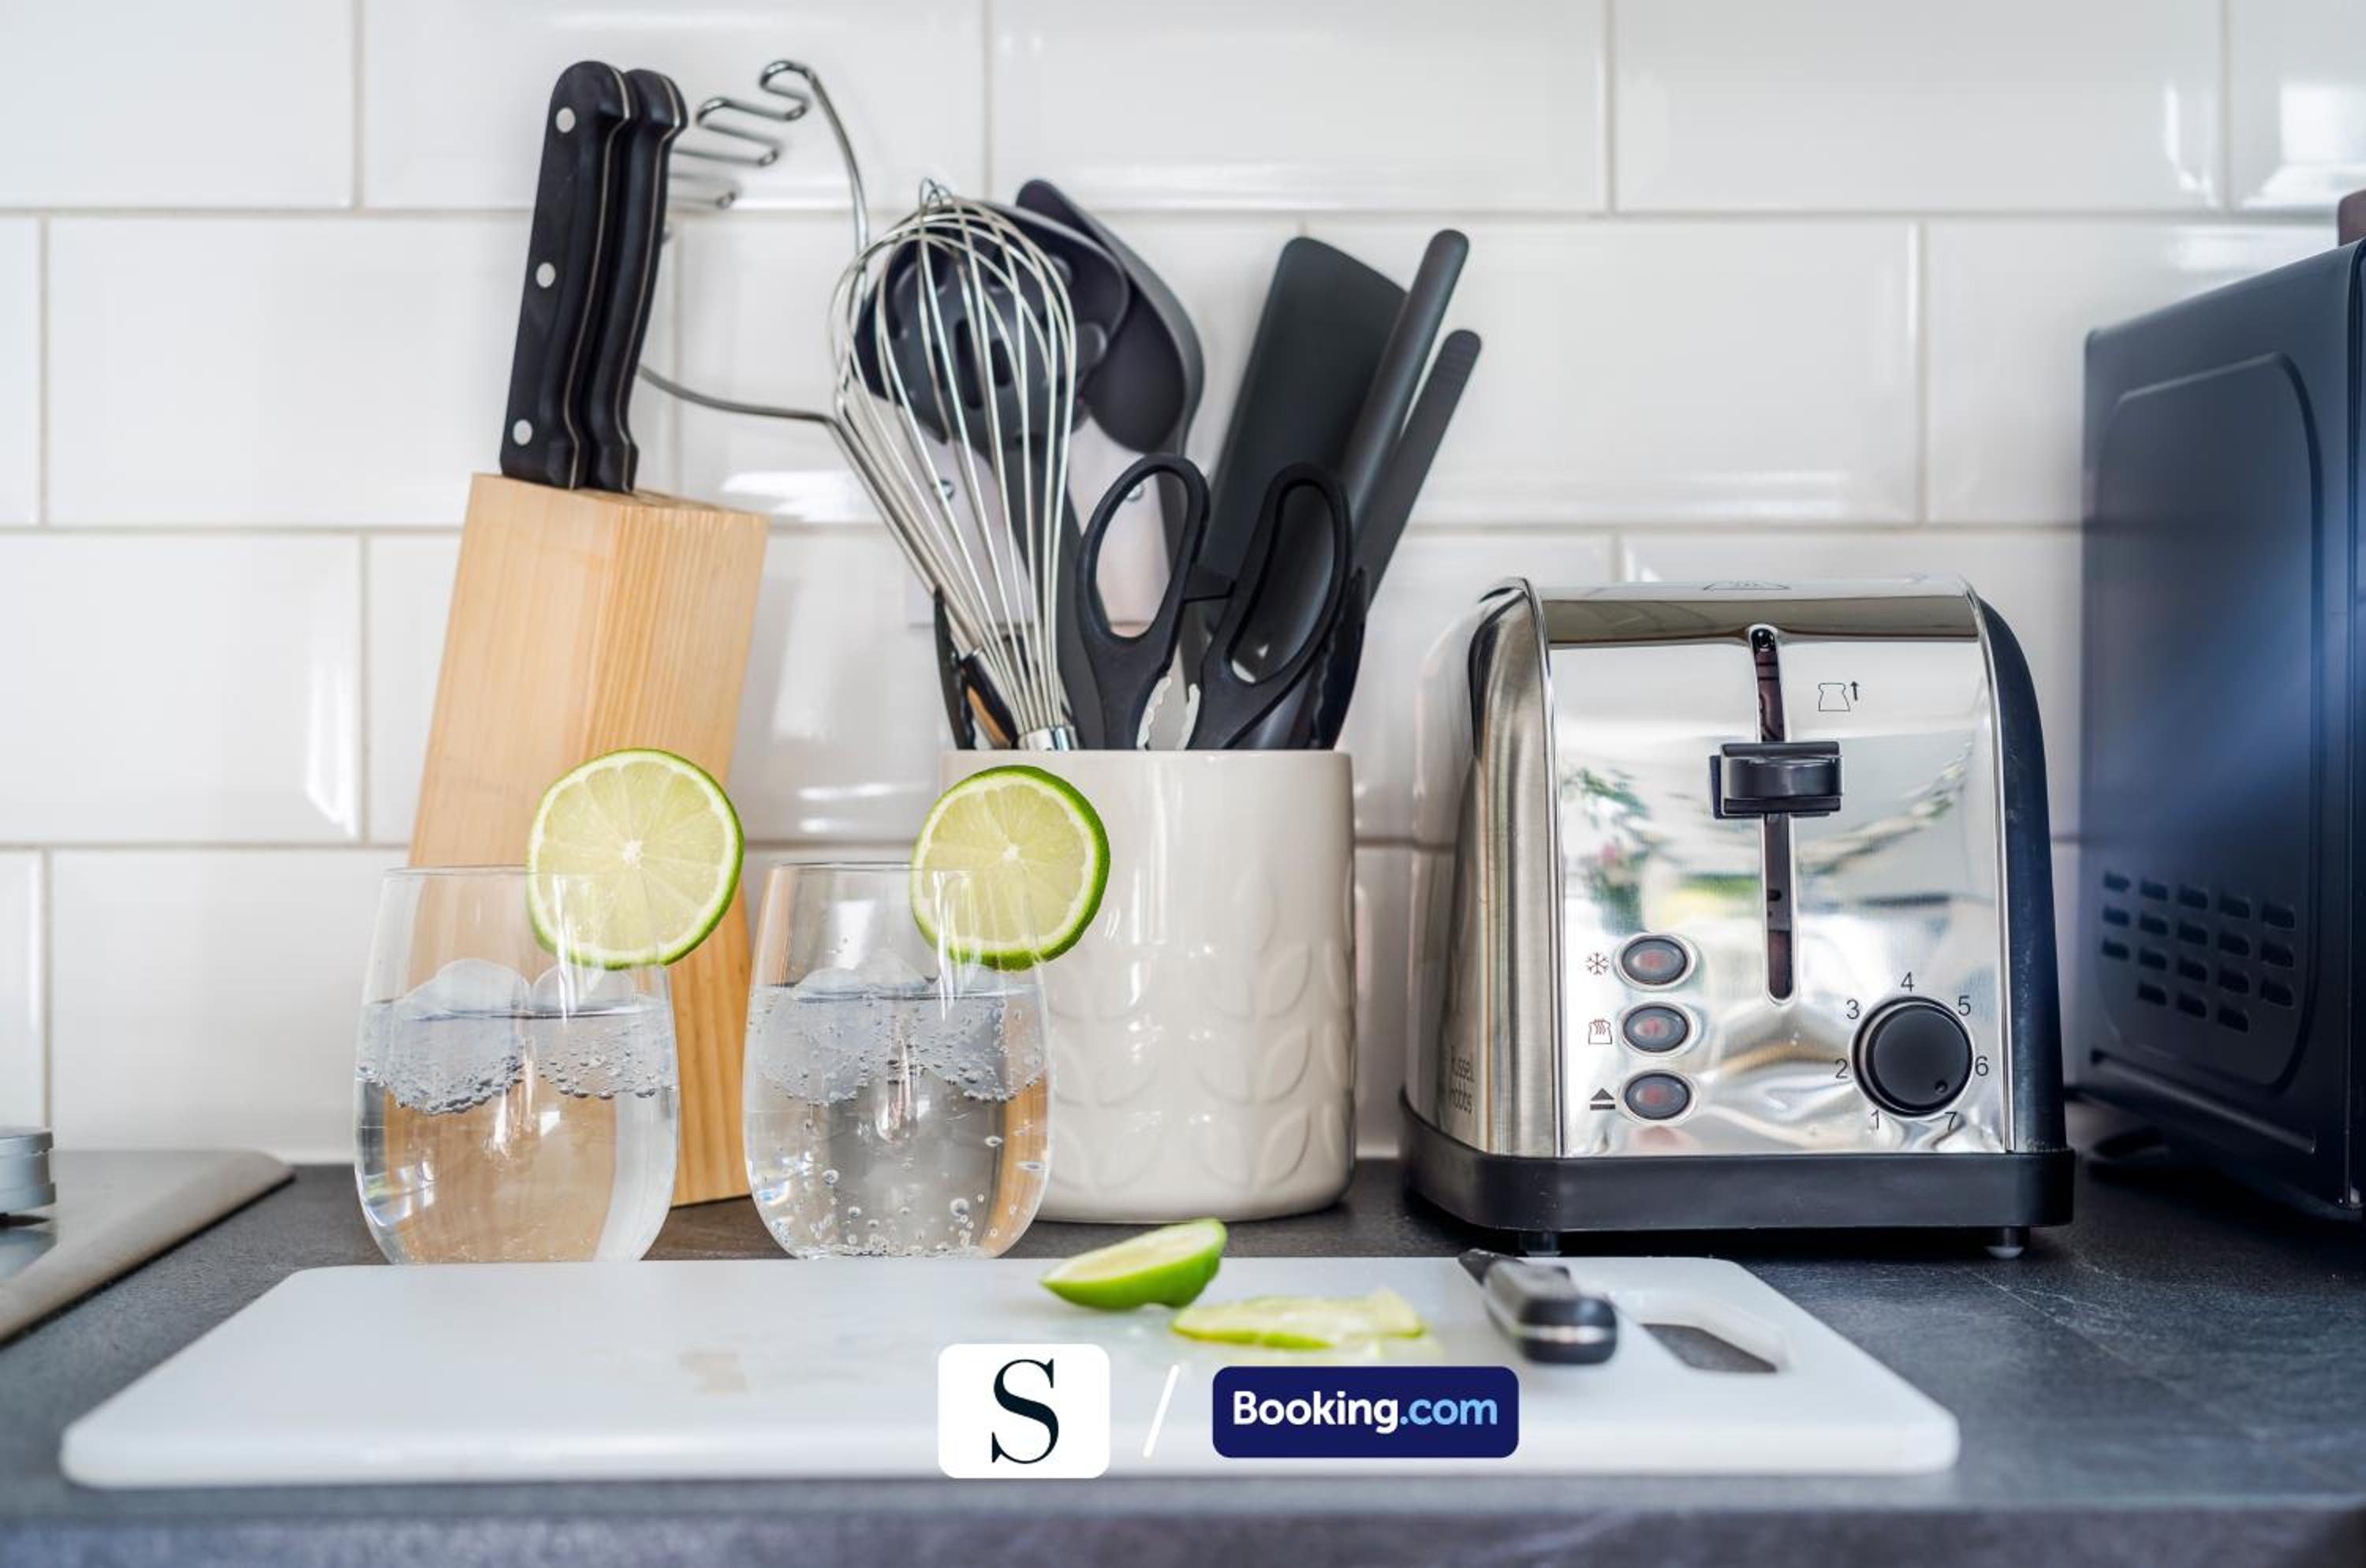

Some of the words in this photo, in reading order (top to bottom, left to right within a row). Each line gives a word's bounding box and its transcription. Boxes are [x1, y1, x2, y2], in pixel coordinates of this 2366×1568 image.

[1901, 972, 1914, 992] 4
[1846, 999, 1860, 1020] 3
[1958, 995, 1971, 1016] 5
[1835, 1058, 1848, 1079] 2
[1975, 1056, 1989, 1077] 6
[1871, 1110, 1880, 1130] 1
[1945, 1111, 1957, 1131] 7
